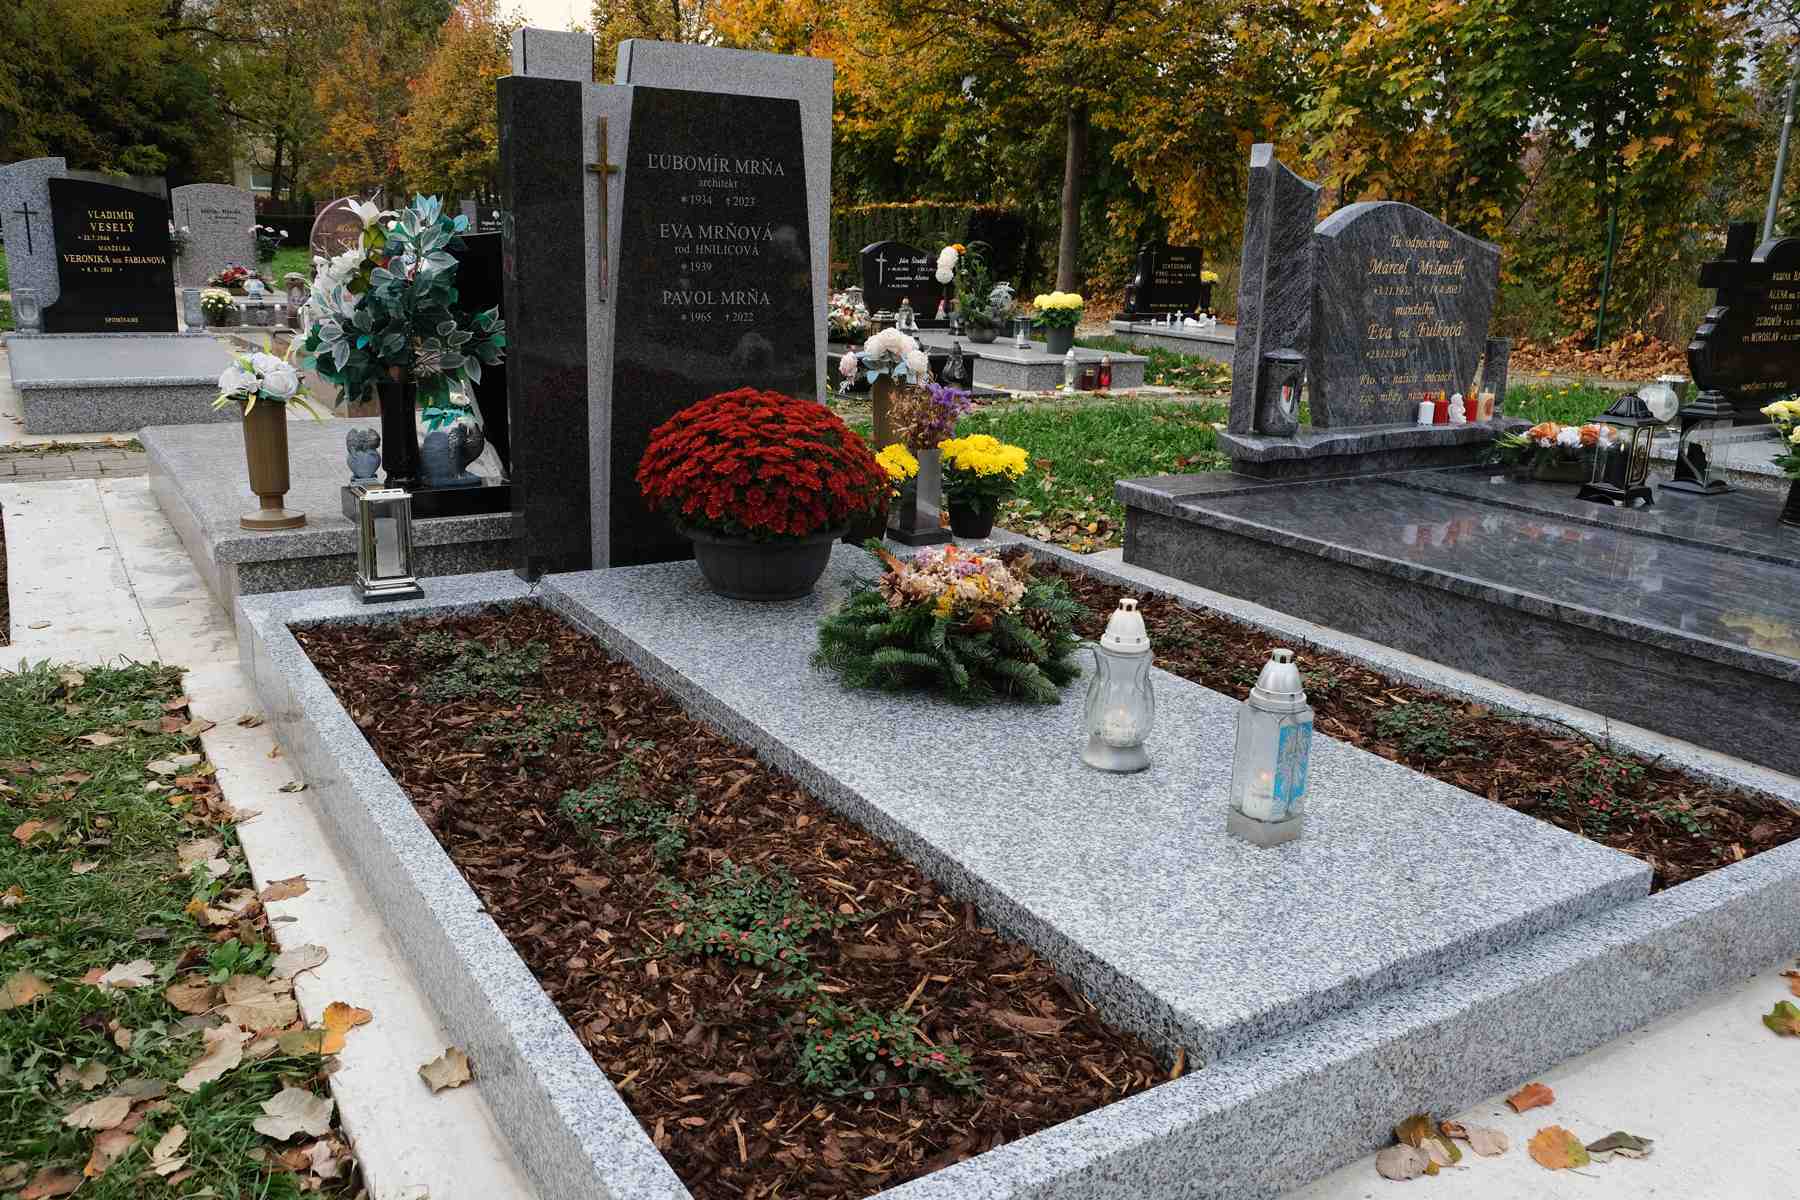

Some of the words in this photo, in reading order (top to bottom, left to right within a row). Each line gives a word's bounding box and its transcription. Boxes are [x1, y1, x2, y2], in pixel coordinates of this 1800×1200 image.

[648, 153, 730, 173] ĽUBOMÍR
[735, 157, 785, 176] MRŇA
[87, 207, 135, 220] VLADIMÍR
[90, 221, 136, 233] VESELÝ
[659, 223, 694, 240] EVA
[698, 222, 774, 241] MRŇOVÁ
[63, 254, 110, 265] VERONIKA
[1368, 256, 1412, 276] Marcel
[662, 290, 716, 305] PAVOL
[720, 288, 771, 305] MRŇA
